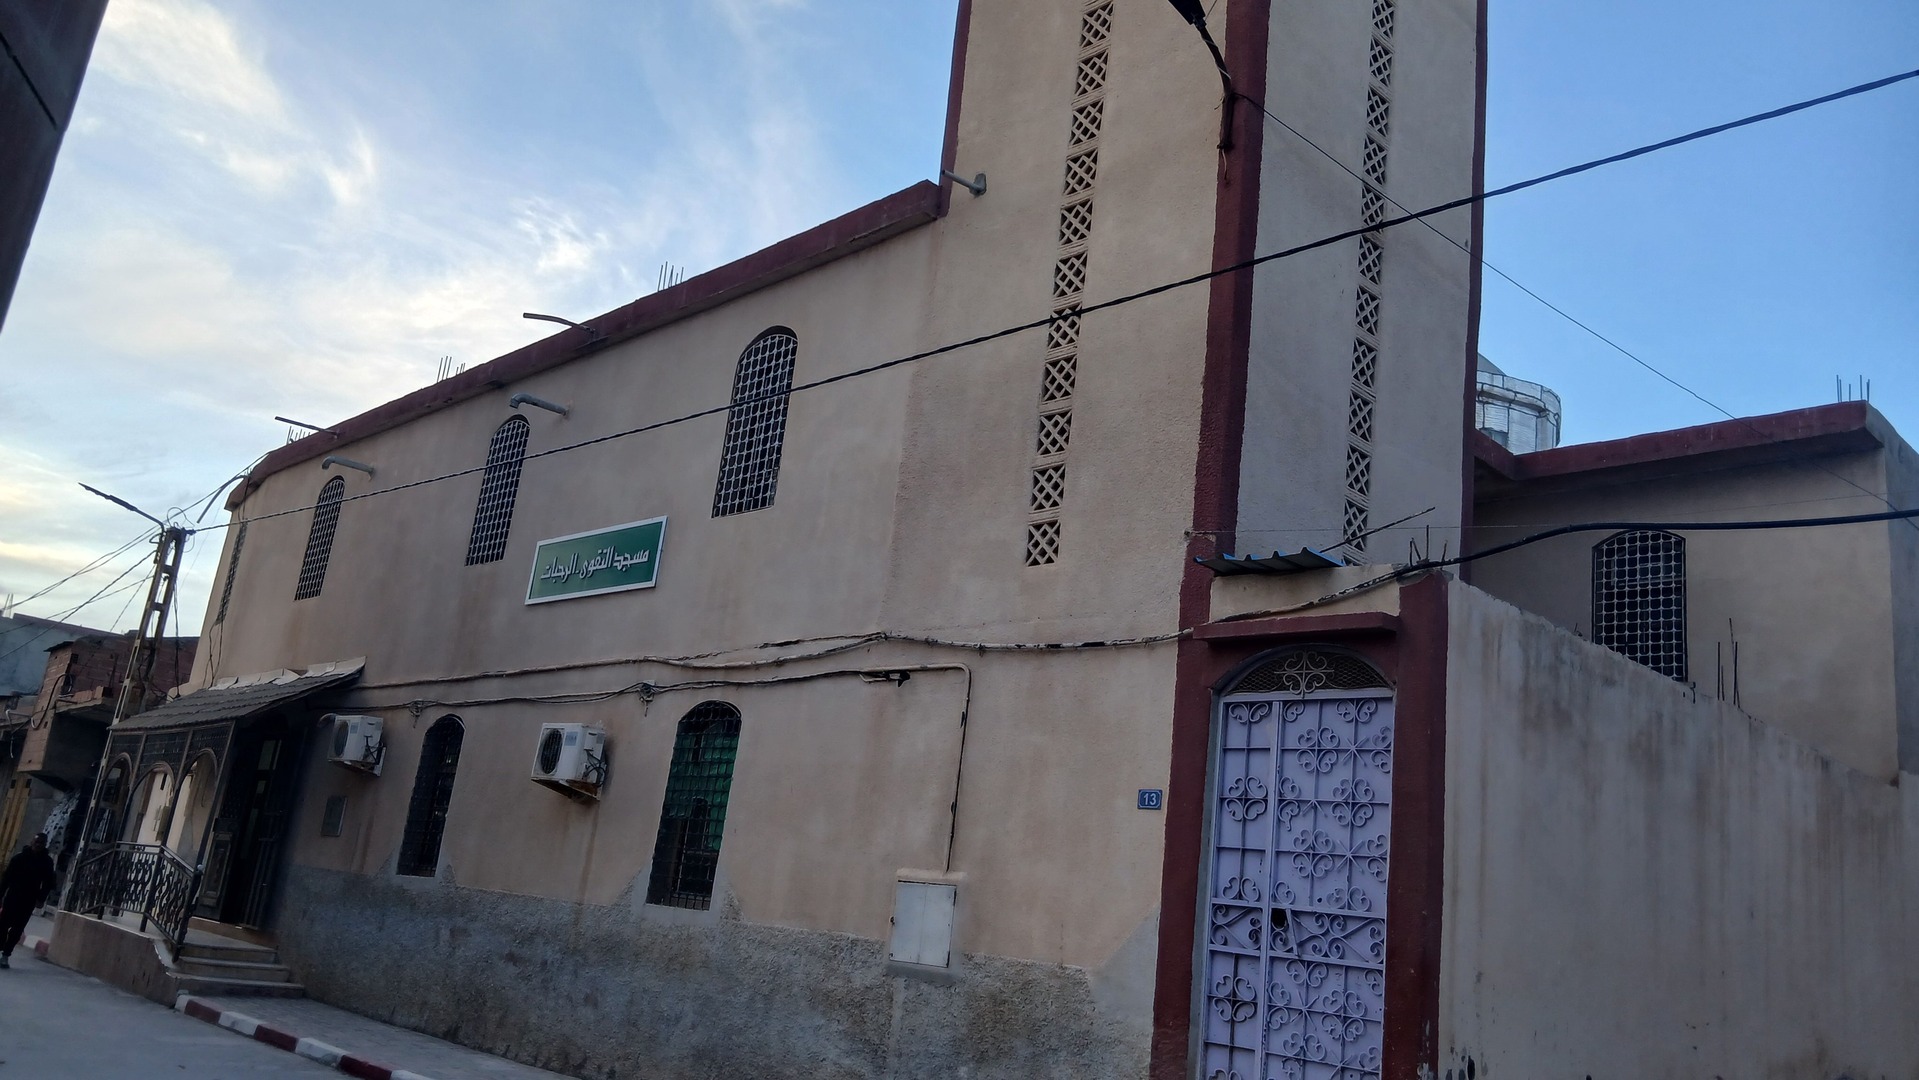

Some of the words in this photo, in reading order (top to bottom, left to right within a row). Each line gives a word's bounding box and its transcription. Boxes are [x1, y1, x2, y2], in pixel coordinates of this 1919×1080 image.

[579, 546, 615, 578] التقوى
[613, 550, 650, 571] مسجد
[1144, 793, 1157, 806] 13
